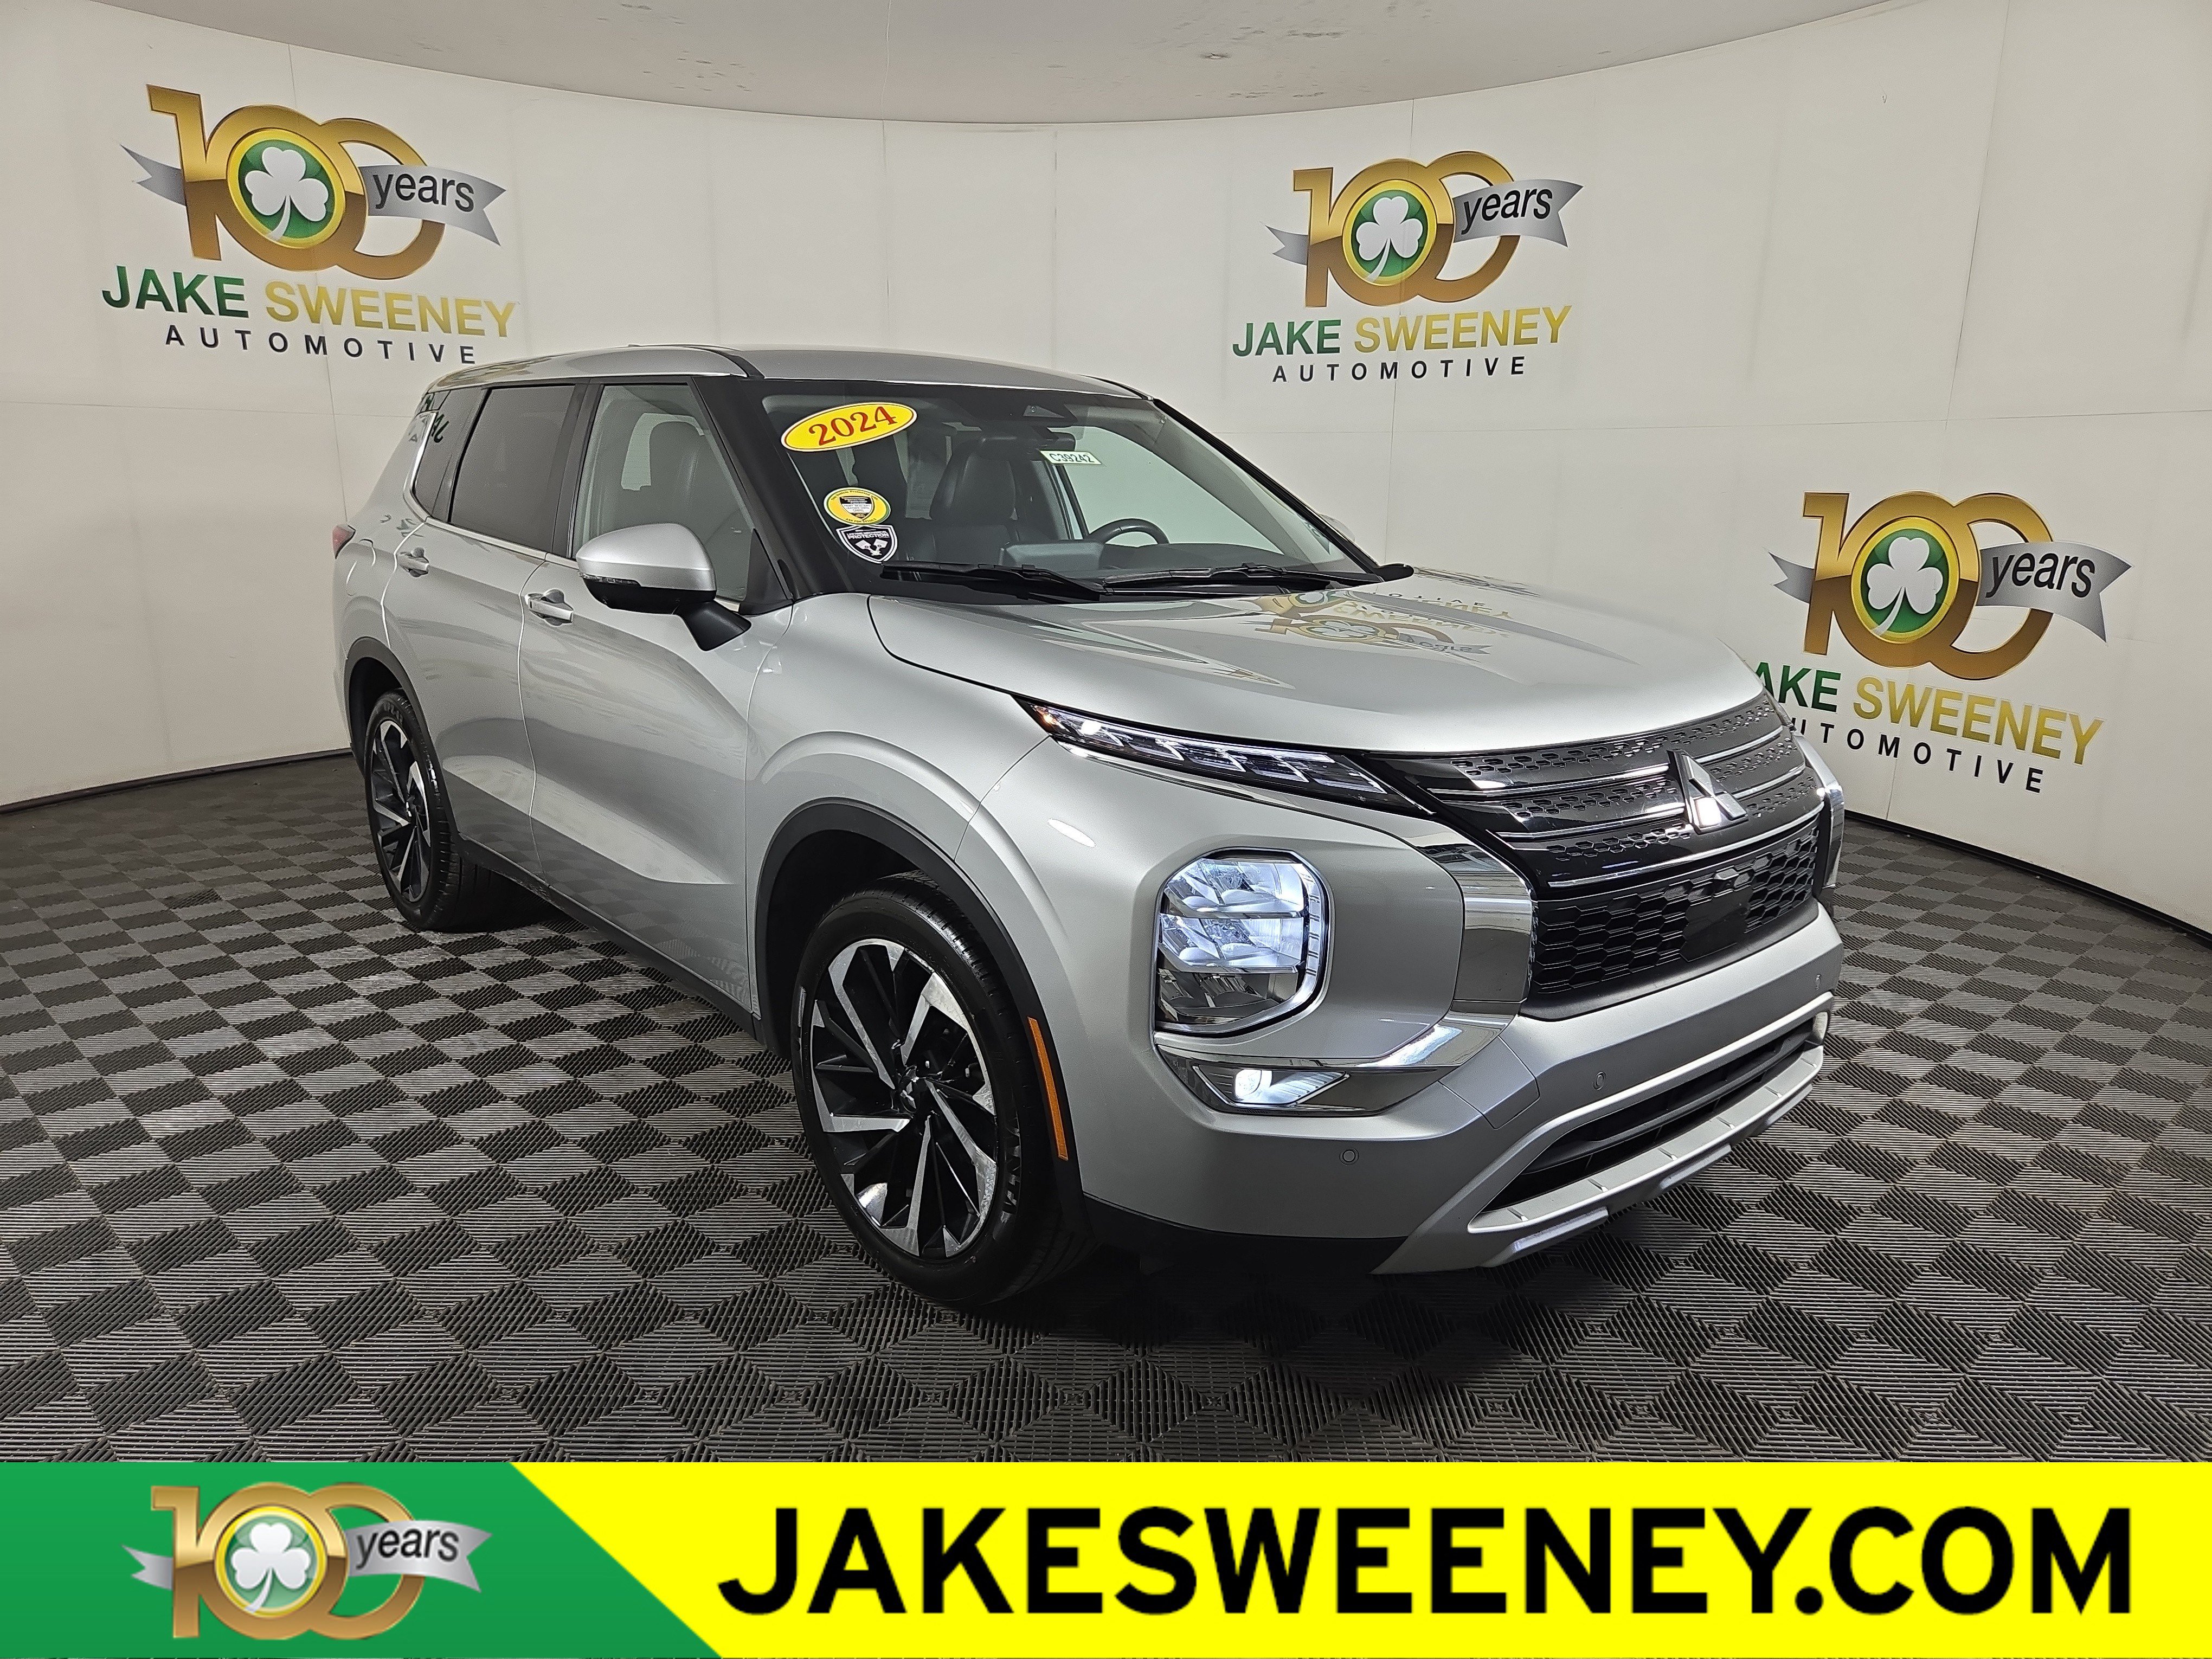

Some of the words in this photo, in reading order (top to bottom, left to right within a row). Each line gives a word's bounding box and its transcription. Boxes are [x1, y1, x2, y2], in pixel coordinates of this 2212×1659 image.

[146, 83, 446, 281] 100
[372, 172, 475, 214] years
[1293, 150, 1520, 308] 100
[1461, 187, 1553, 235] years
[101, 265, 249, 319] JAKE
[265, 280, 517, 338] SWEENEY
[1232, 319, 1342, 357] JAKE
[1354, 305, 1572, 354] SWEENEY
[165, 324, 475, 365] AUTOMOTIVE
[1272, 356, 1526, 382] AUTOMOTIVE
[808, 406, 898, 446] 2024
[1049, 453, 1095, 463] C39242
[1802, 490, 2055, 681] 100
[1985, 551, 2096, 599] years
[1755, 661, 1842, 712] AKE
[1853, 675, 2103, 766] SWEENEY
[1790, 717, 2044, 794] UTOMOTIVE
